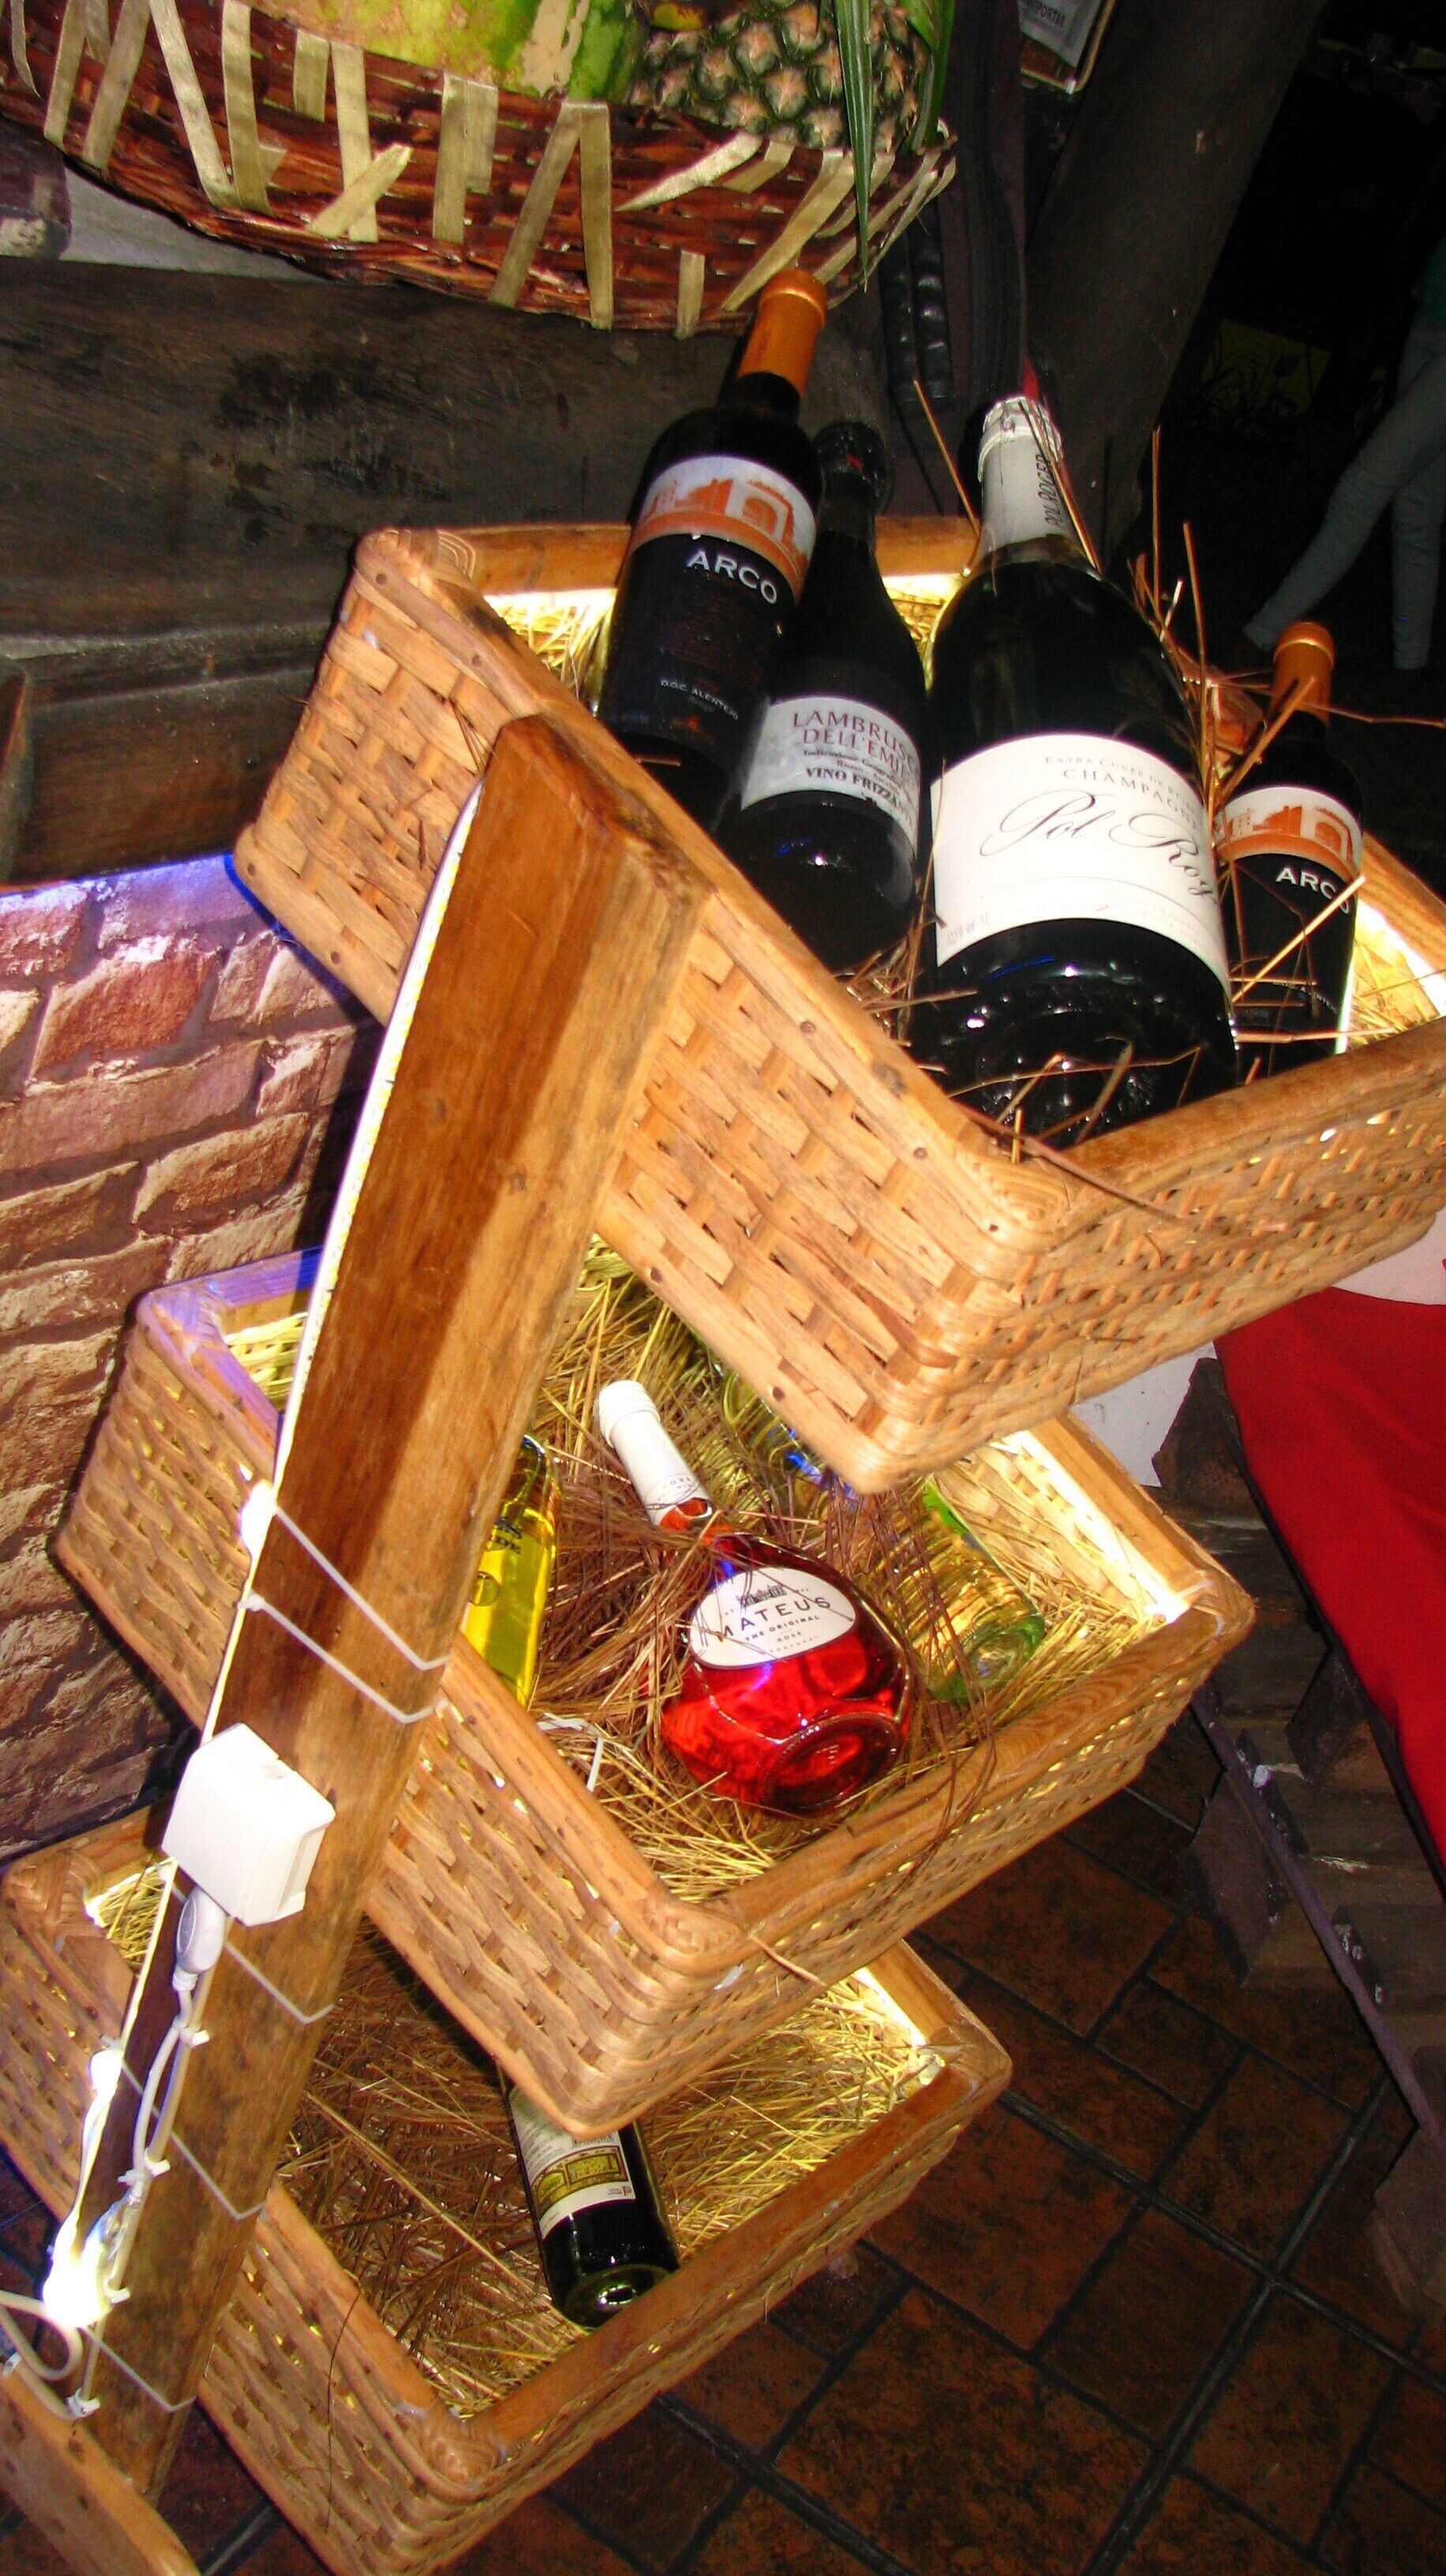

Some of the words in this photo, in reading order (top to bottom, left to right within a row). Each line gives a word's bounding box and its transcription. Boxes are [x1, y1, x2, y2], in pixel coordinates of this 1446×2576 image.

[685, 549, 777, 605] ARCO
[792, 710, 917, 773] LAMBRUSC
[1045, 756, 1093, 765] EXTRA
[806, 767, 847, 782] VINO
[980, 789, 1116, 857] Pol
[717, 1597, 831, 1638] MATEUS
[745, 1631, 765, 1642] THE
[769, 1615, 820, 1632] ORIGINAL
